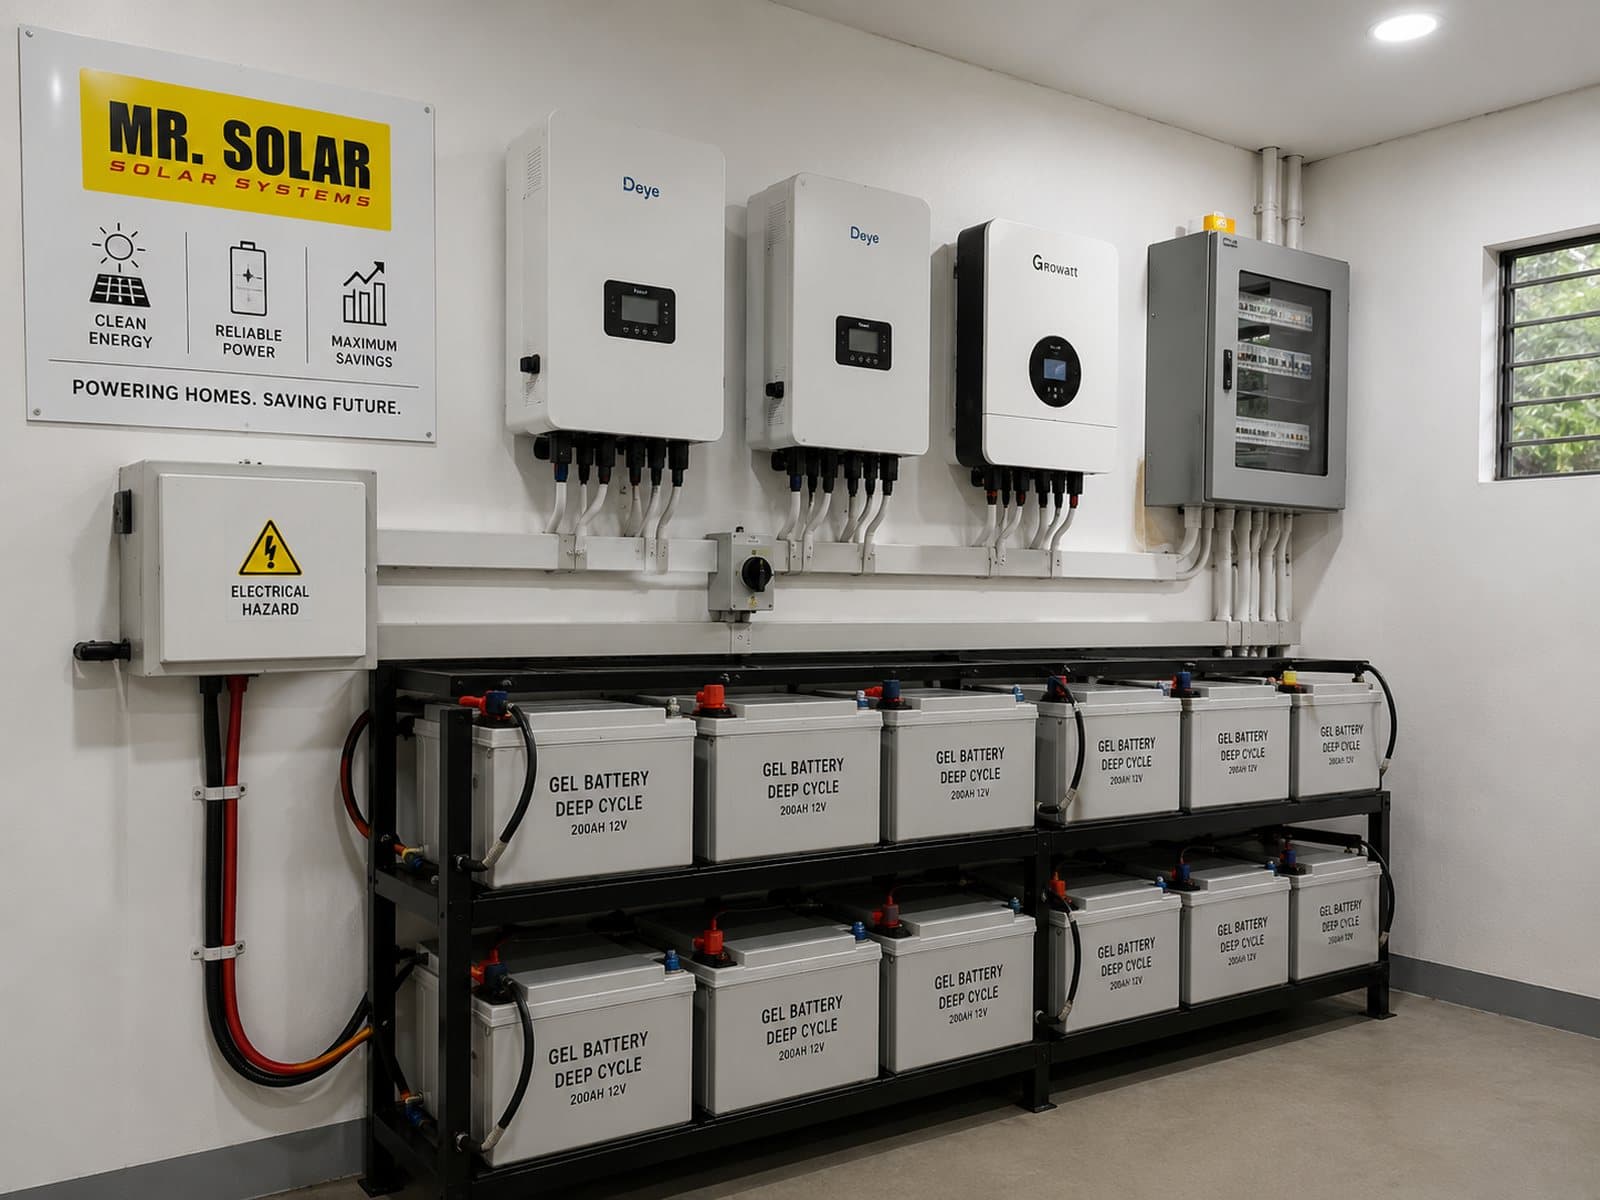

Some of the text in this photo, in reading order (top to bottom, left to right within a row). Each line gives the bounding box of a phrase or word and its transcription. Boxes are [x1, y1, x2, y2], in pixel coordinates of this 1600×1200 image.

[110, 101, 370, 189] MR. SOLAR
[110, 161, 370, 207] SOLAR SYSTEMS
[624, 177, 659, 200] Deye
[851, 226, 879, 246] Deye
[96, 314, 146, 330] CLEAN
[90, 332, 152, 348] ENERGY
[216, 325, 282, 342] RELIABLE
[224, 343, 275, 358] POWER
[332, 336, 397, 352] MAXIMUM
[337, 352, 392, 368] SAVINGS
[74, 380, 401, 415] POWERING HOMES. SAVING FUTURE.
[232, 586, 309, 598] ELECTRICAL
[243, 603, 299, 616] HAZARD
[1218, 730, 1268, 744] GEL BATTERY
[1321, 724, 1363, 737] GEL BATTERY
[1098, 737, 1156, 752] GEL BATTERY
[1323, 740, 1360, 753] DEEP CYCLE
[937, 747, 1005, 764] GEL BATTERY
[1221, 747, 1265, 761] DEEP CYCLE
[764, 758, 844, 777] GEL BATTERY
[1102, 756, 1152, 771] DEEP CYCLE
[550, 771, 649, 793] GEL BATTERY
[941, 768, 1000, 784] DEEP CYCLE
[768, 780, 839, 799] DEEP CYCLE
[952, 788, 989, 800] 200AH 12V
[556, 795, 642, 817] DEEP CYCLE
[780, 802, 826, 816] 200AH 12V
[572, 820, 627, 835] 200AH 12V
[1320, 900, 1362, 917] GEL BATTERY
[1218, 917, 1268, 936] GEL BATTERY
[1322, 916, 1359, 933] DEEP CYCLE
[1098, 937, 1155, 959] GEL BATTERY
[1221, 934, 1264, 953] DEEP CYCLE
[1102, 956, 1152, 977] DEEP CYCLE
[935, 964, 1003, 990] GEL BATTERY
[940, 986, 998, 1009] DEEP CYCLE
[762, 995, 843, 1024] GEL BATTERY
[950, 1008, 988, 1024] 200AH 12V
[767, 1018, 837, 1045] DEEP CYCLE
[549, 1031, 648, 1065] GEL BATTERY
[779, 1042, 824, 1061] 200AH 12V
[556, 1057, 642, 1088] DEEP CYCLE
[571, 1084, 626, 1105] 200AH 12V
